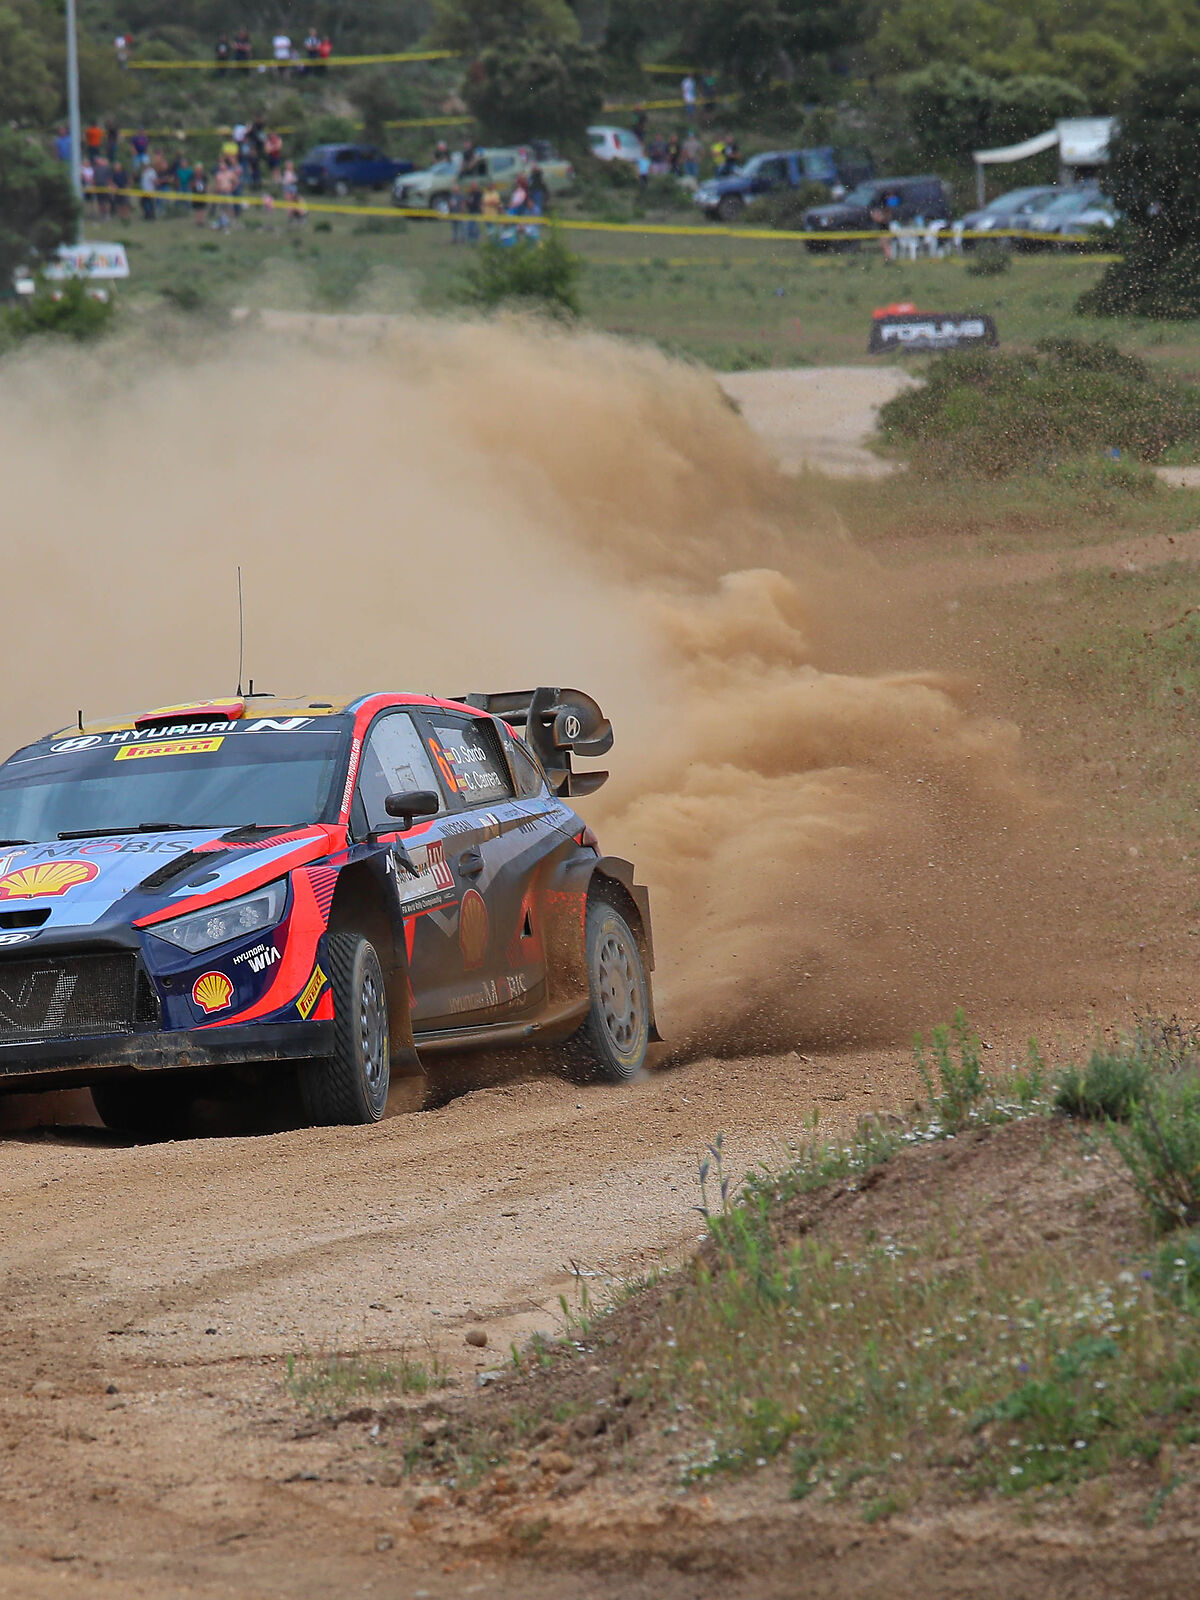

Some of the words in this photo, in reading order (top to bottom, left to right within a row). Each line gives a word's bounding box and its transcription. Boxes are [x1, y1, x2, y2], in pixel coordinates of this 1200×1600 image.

[108, 720, 238, 743] HYUNDAI
[125, 739, 216, 757] PIRELLI
[451, 746, 466, 764] D.
[460, 743, 487, 763] Sordo
[428, 737, 458, 793] 6
[464, 772, 478, 790] C.
[32, 840, 192, 859] MOBIS
[233, 943, 266, 965] HYUNDAI
[247, 946, 282, 973] WIA
